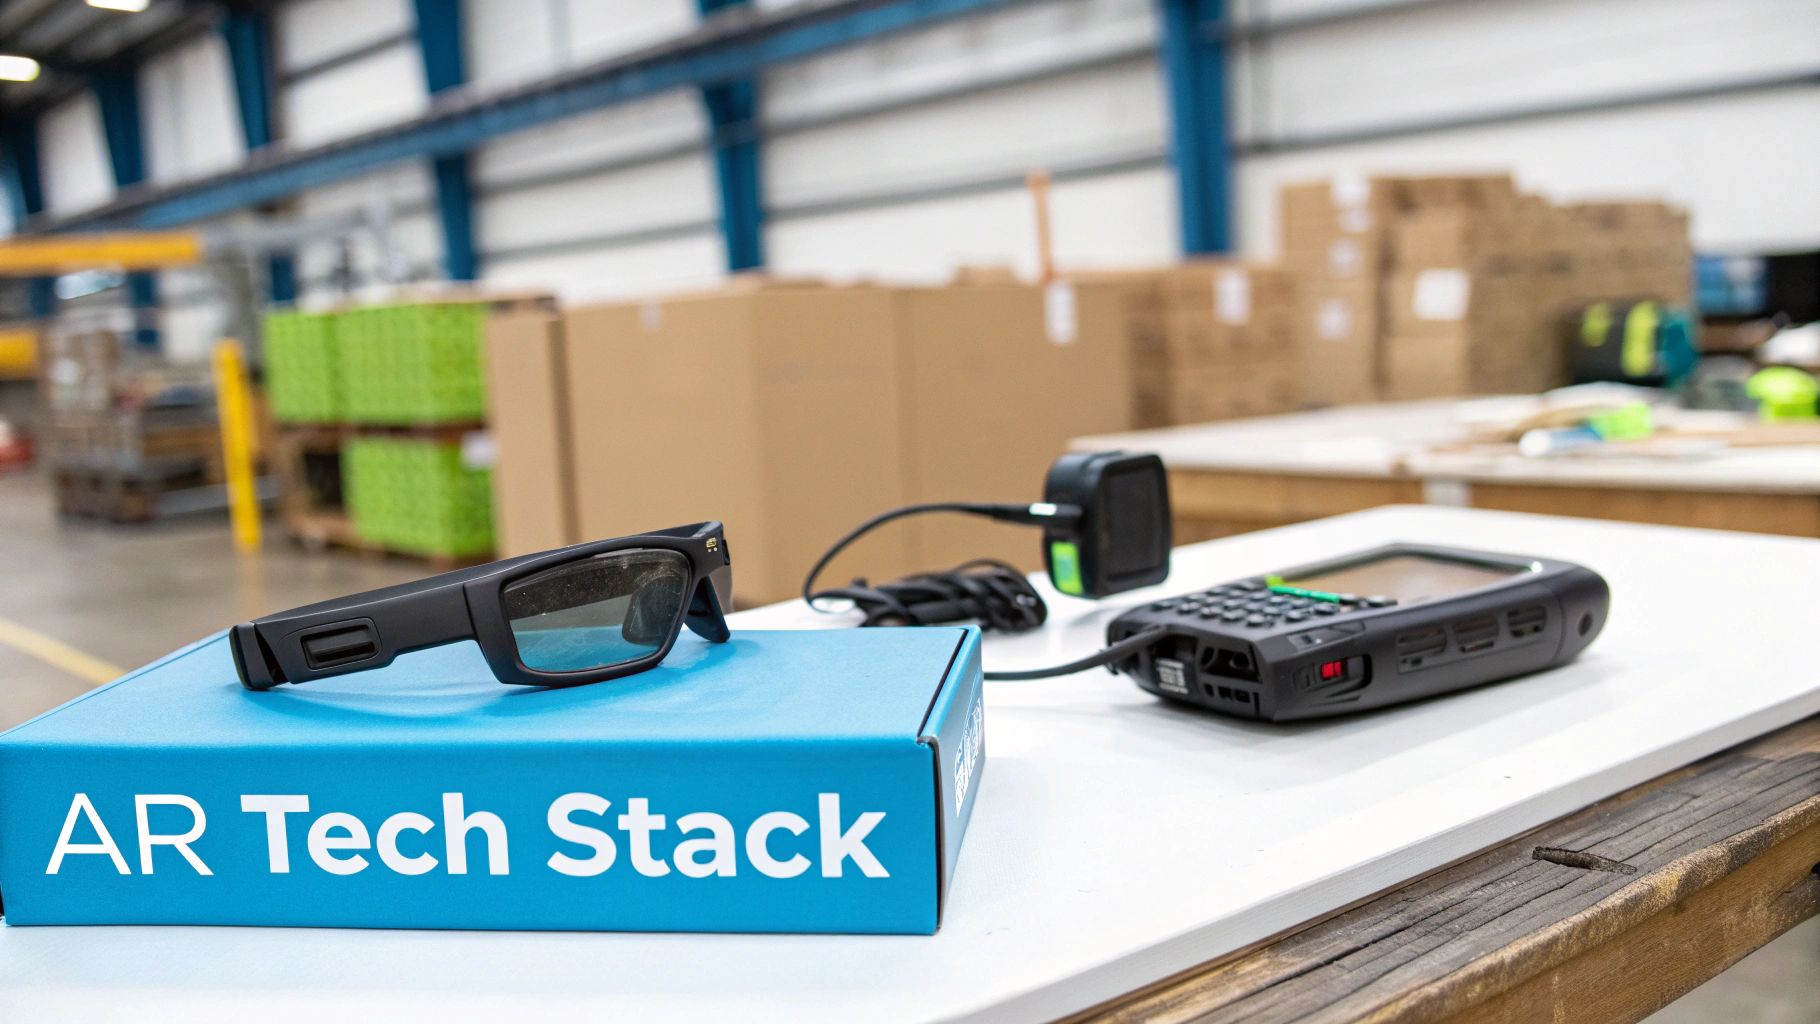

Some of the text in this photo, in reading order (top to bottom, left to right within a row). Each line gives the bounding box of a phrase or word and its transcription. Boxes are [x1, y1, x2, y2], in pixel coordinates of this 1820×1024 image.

[45, 791, 890, 878] AR Tech Stack
